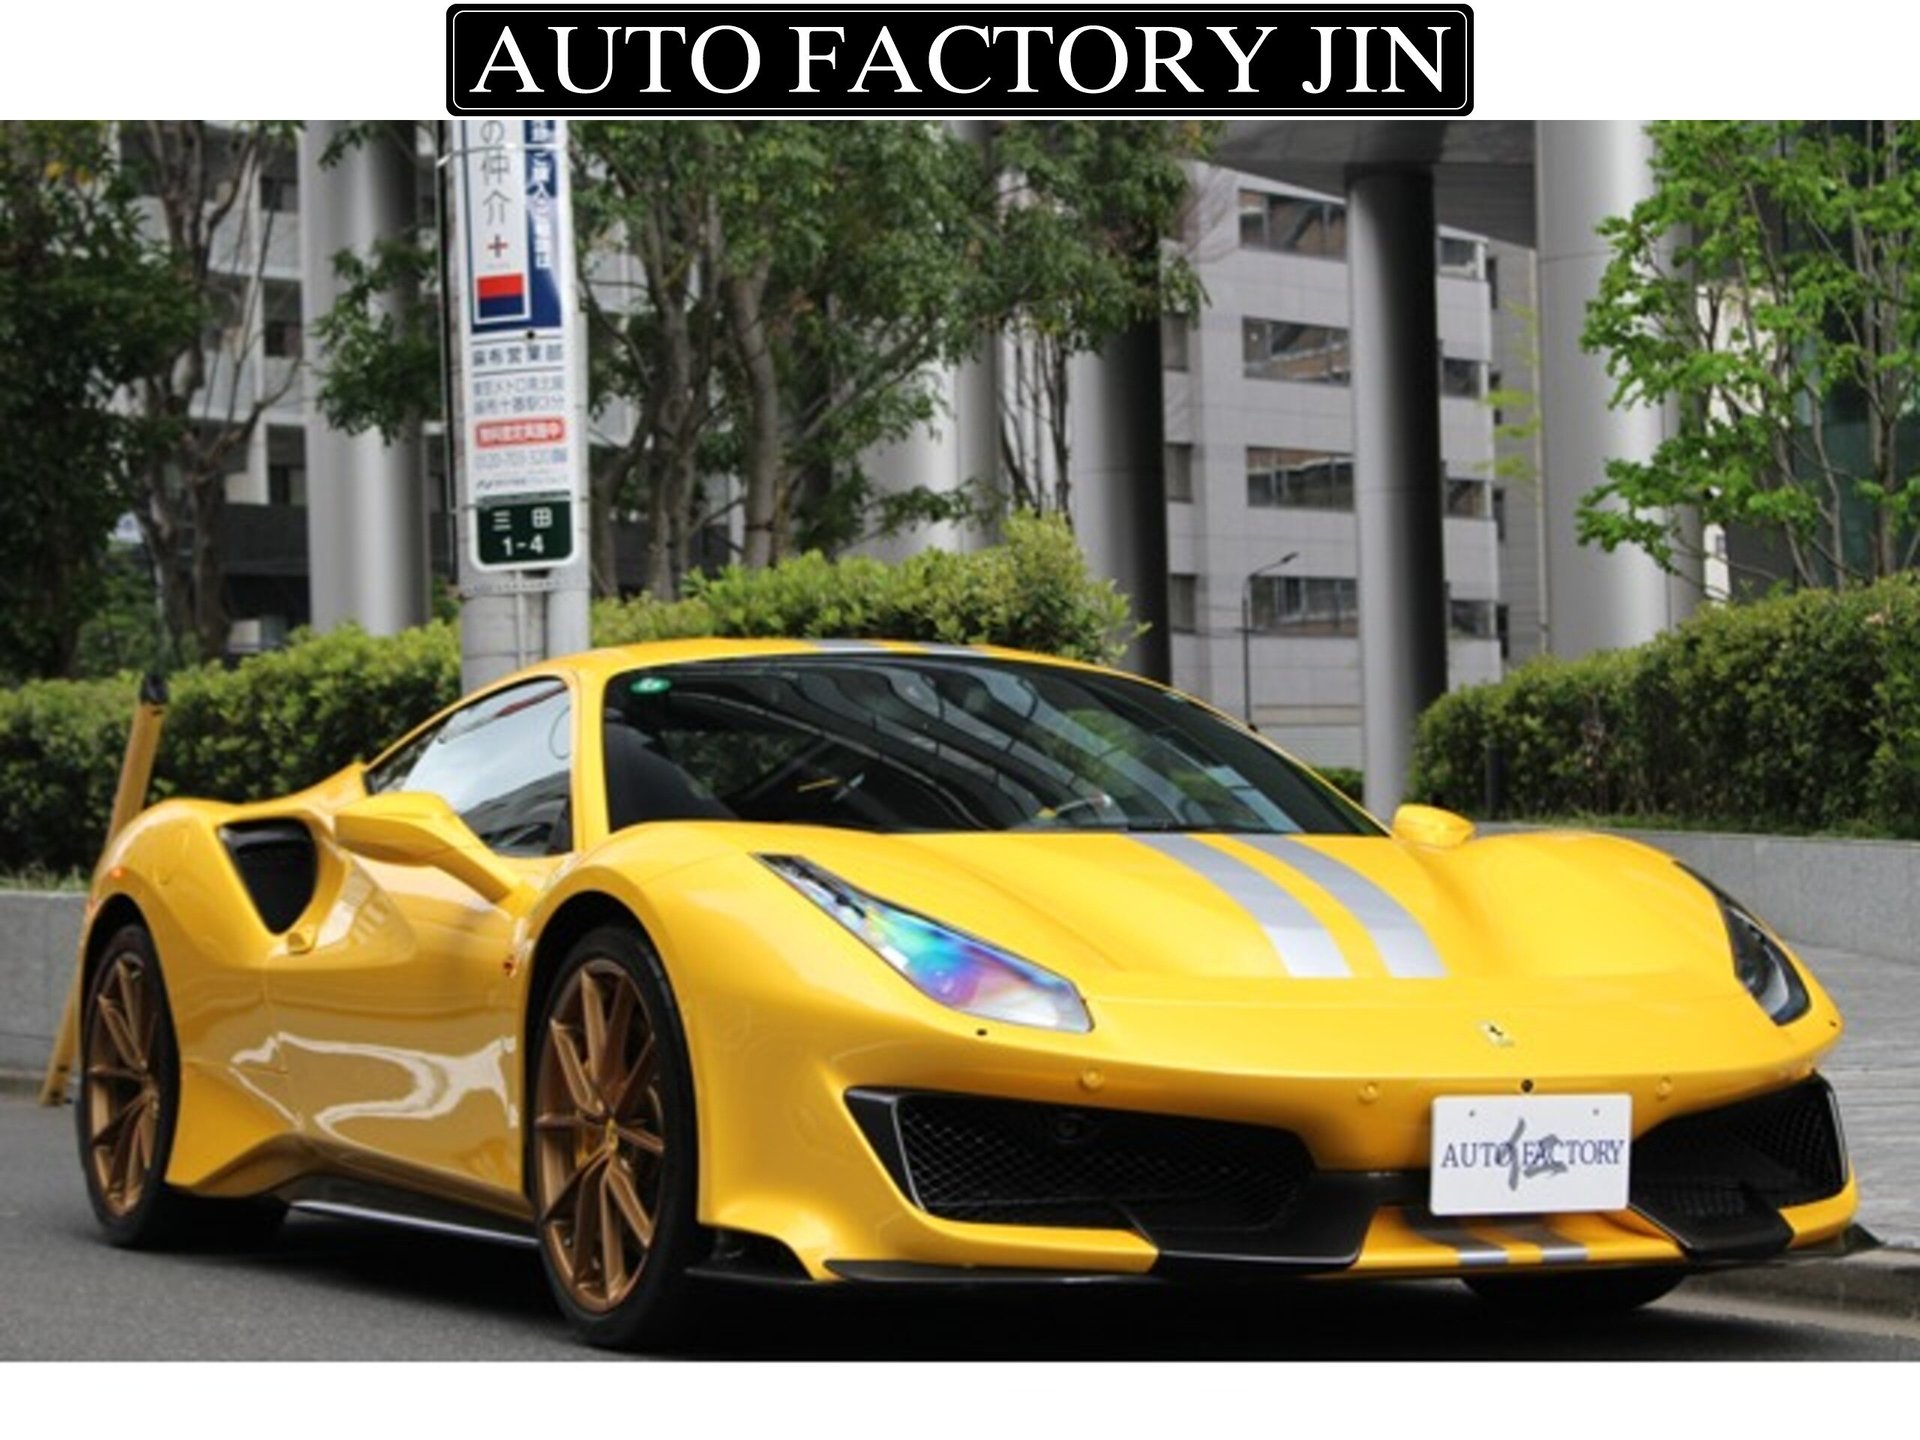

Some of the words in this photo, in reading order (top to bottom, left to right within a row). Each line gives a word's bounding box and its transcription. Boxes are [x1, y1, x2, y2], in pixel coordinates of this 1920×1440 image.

[502, 534, 545, 556] 1-4
[1441, 1142, 1514, 1168] AUTO
[1522, 1139, 1625, 1166] FACTORY
